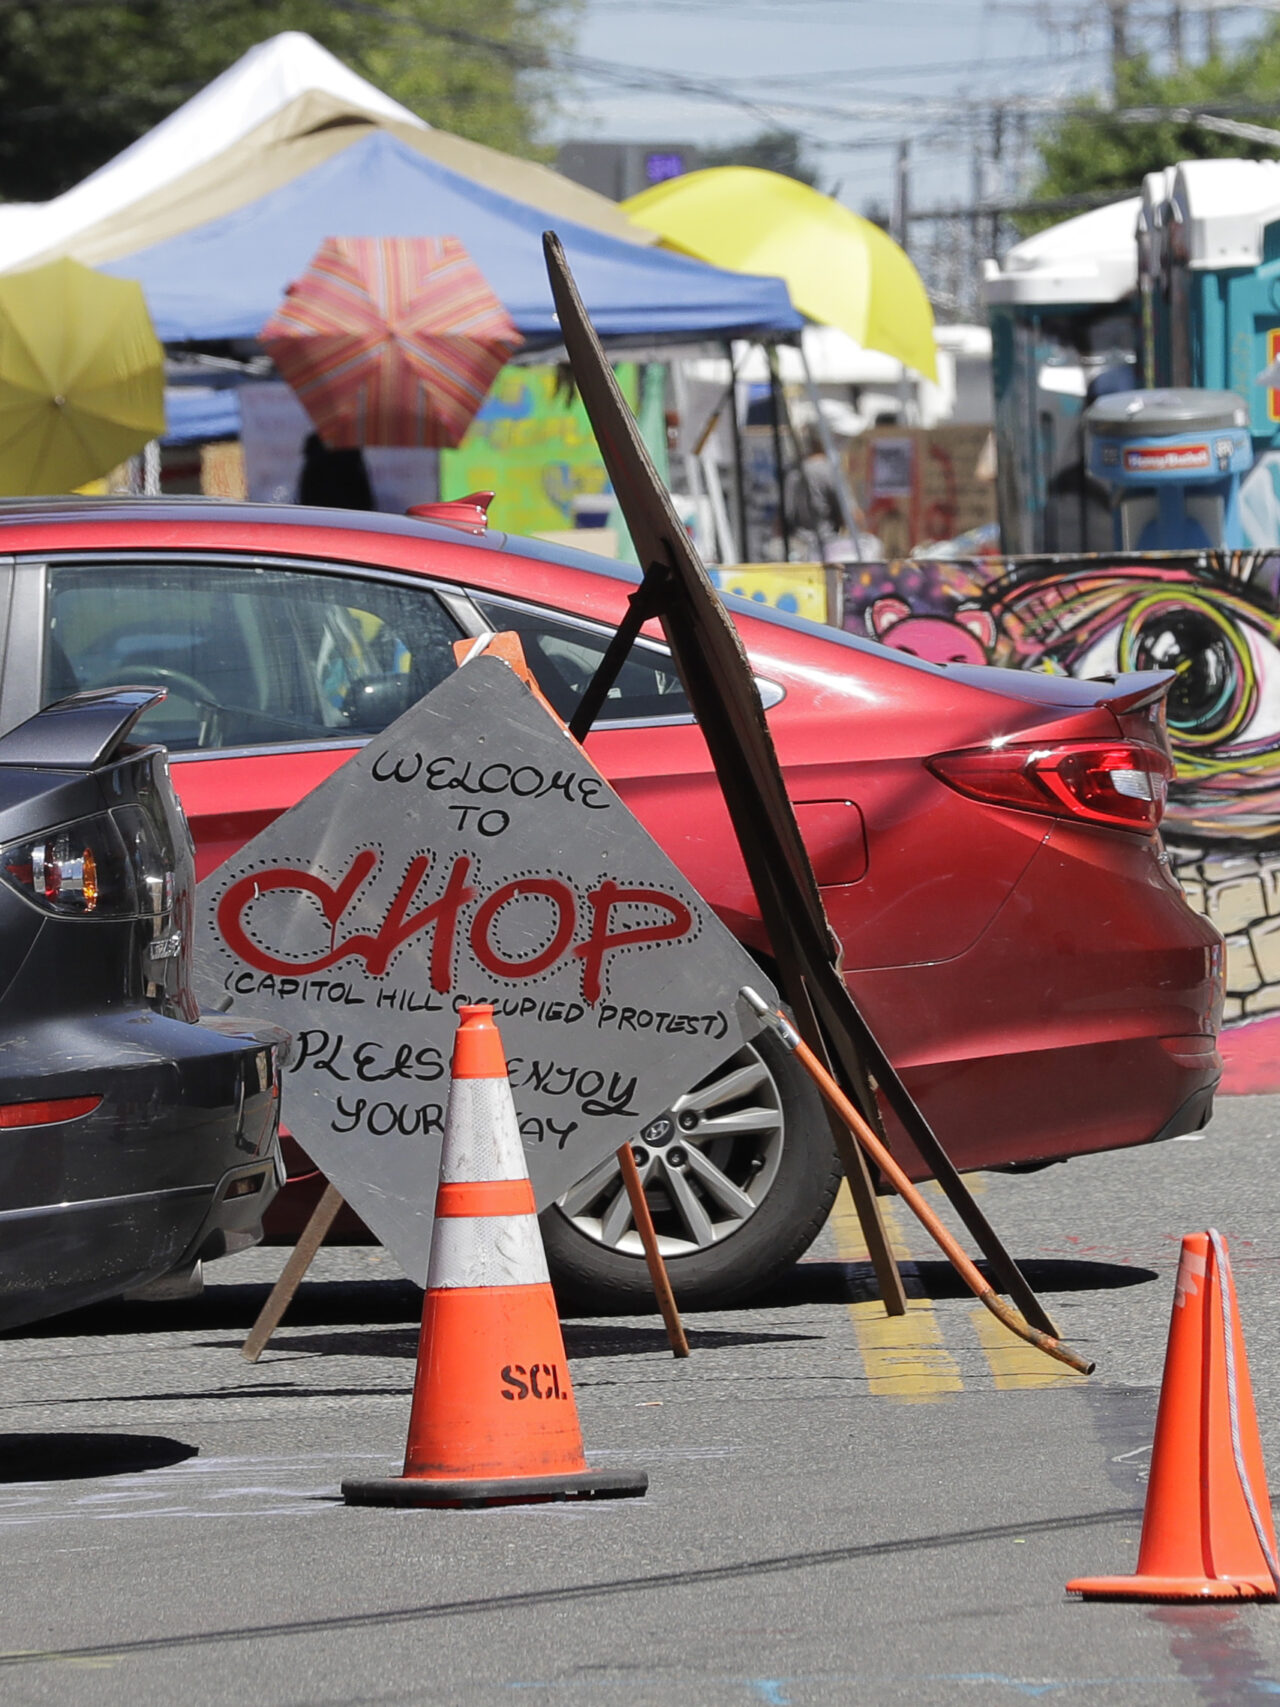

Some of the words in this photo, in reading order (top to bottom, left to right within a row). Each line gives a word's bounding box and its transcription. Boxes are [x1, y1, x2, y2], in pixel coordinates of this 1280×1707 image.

[372, 751, 610, 810] WELCOME
[449, 805, 510, 837] TO
[215, 847, 694, 1003] CHOP
[224, 971, 366, 1005] (CAPITOL
[376, 988, 443, 1012] HILL
[597, 1006, 729, 1040] PROTEST)
[290, 1030, 453, 1082] PLEAS
[505, 1057, 640, 1117] ENJOY
[331, 1096, 445, 1136] YOUR
